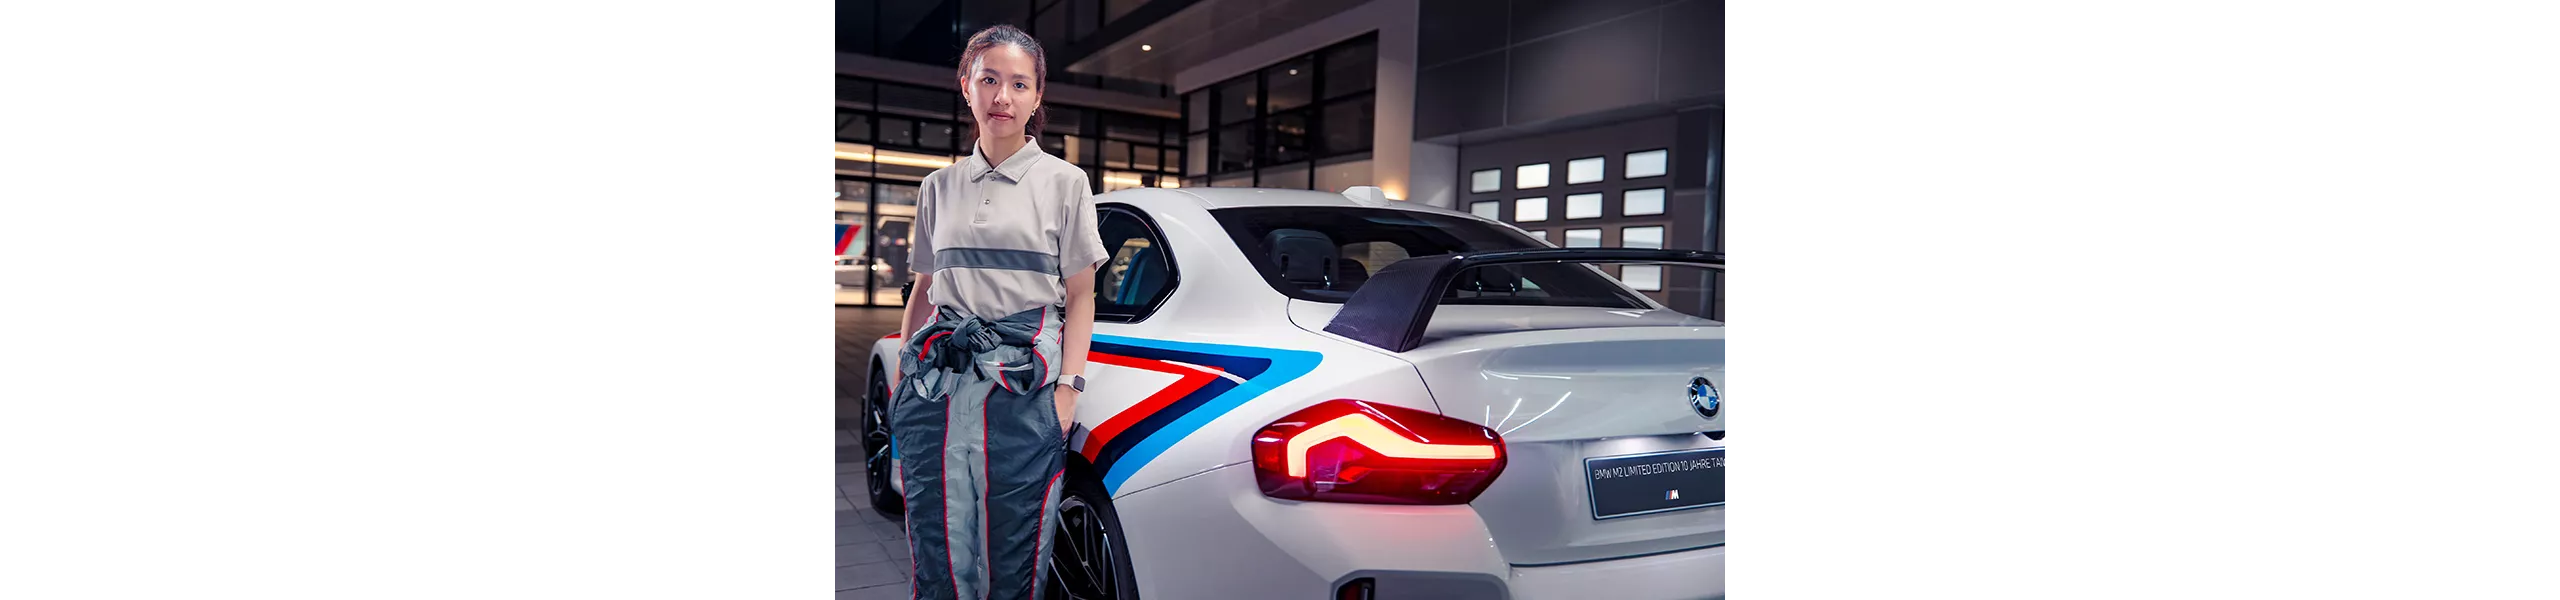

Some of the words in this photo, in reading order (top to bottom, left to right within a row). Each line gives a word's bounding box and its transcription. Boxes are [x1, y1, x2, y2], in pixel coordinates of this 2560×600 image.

[1594, 468, 1611, 480] BMW
[1612, 466, 1623, 478] M2
[1623, 464, 1651, 477] LIMITED
[1652, 461, 1680, 474] EDITION
[1681, 460, 1689, 471] 10
[1689, 458, 1711, 471] JAHRE
